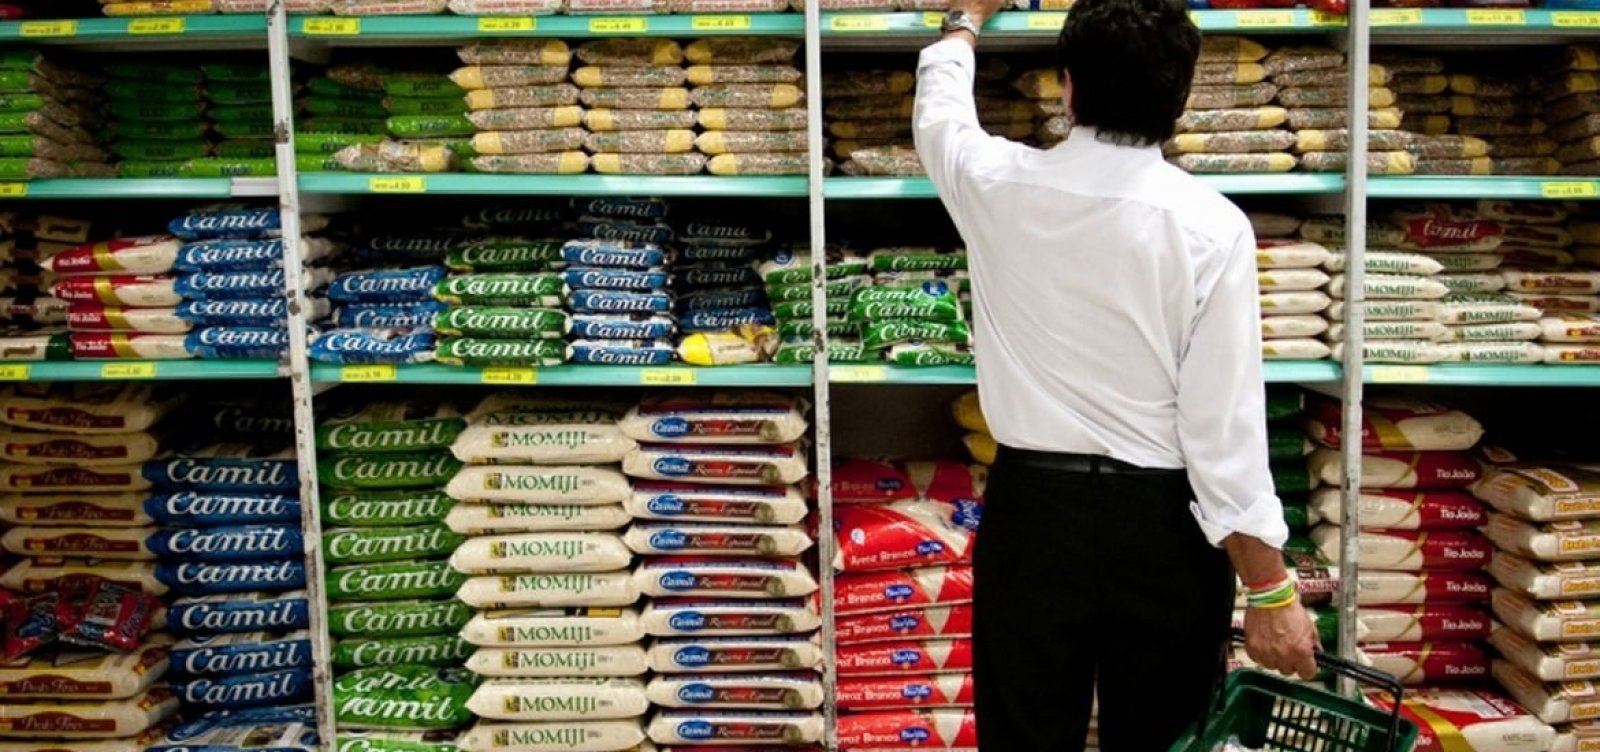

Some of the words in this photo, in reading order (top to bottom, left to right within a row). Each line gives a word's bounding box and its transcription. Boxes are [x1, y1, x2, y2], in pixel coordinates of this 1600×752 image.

[183, 208, 272, 229] Camil
[185, 241, 280, 264] Camil
[462, 243, 549, 264] Camil
[580, 249, 648, 266] Camil
[190, 269, 286, 290] Camil
[343, 272, 432, 293] Camil
[450, 275, 545, 295] Camil
[583, 271, 650, 289] Camil
[586, 294, 655, 310] Camil
[865, 301, 936, 318] Camil
[450, 308, 545, 330] Camil
[586, 320, 654, 338] Camil
[327, 332, 416, 352] Camil
[451, 338, 545, 358] Camil
[588, 348, 657, 364] Camil
[328, 422, 447, 450] Camil
[510, 431, 587, 449] MOMIJI
[167, 460, 286, 486] Camil
[335, 455, 450, 481] Camil
[504, 473, 579, 494] MOMIJI
[166, 490, 286, 516] Camil
[328, 495, 444, 521] Camil
[508, 503, 582, 521] MOMIJI
[1440, 509, 1456, 519] Tio
[168, 526, 289, 554] Camil
[330, 528, 446, 556] Camil
[510, 540, 583, 559] MOMIJI
[1444, 547, 1459, 558] Tio
[1459, 547, 1484, 559] João
[177, 560, 297, 585] Camil
[340, 562, 455, 594] Camil
[518, 574, 592, 594] MOMIJI
[1446, 581, 1461, 592] Tio
[1461, 580, 1487, 593] João
[182, 601, 297, 630] Camil
[344, 603, 460, 634] Camil
[1441, 619, 1456, 630] Tio
[1456, 619, 1483, 631] João
[516, 625, 592, 645] MOMIJI
[185, 642, 303, 675] Camil
[353, 635, 474, 667] Camil
[520, 651, 596, 671] MOMIJI
[1445, 664, 1460, 675] Tio
[186, 673, 296, 705] Camil
[523, 695, 597, 715] MOMIJI
[512, 727, 586, 747] MOMIJI
